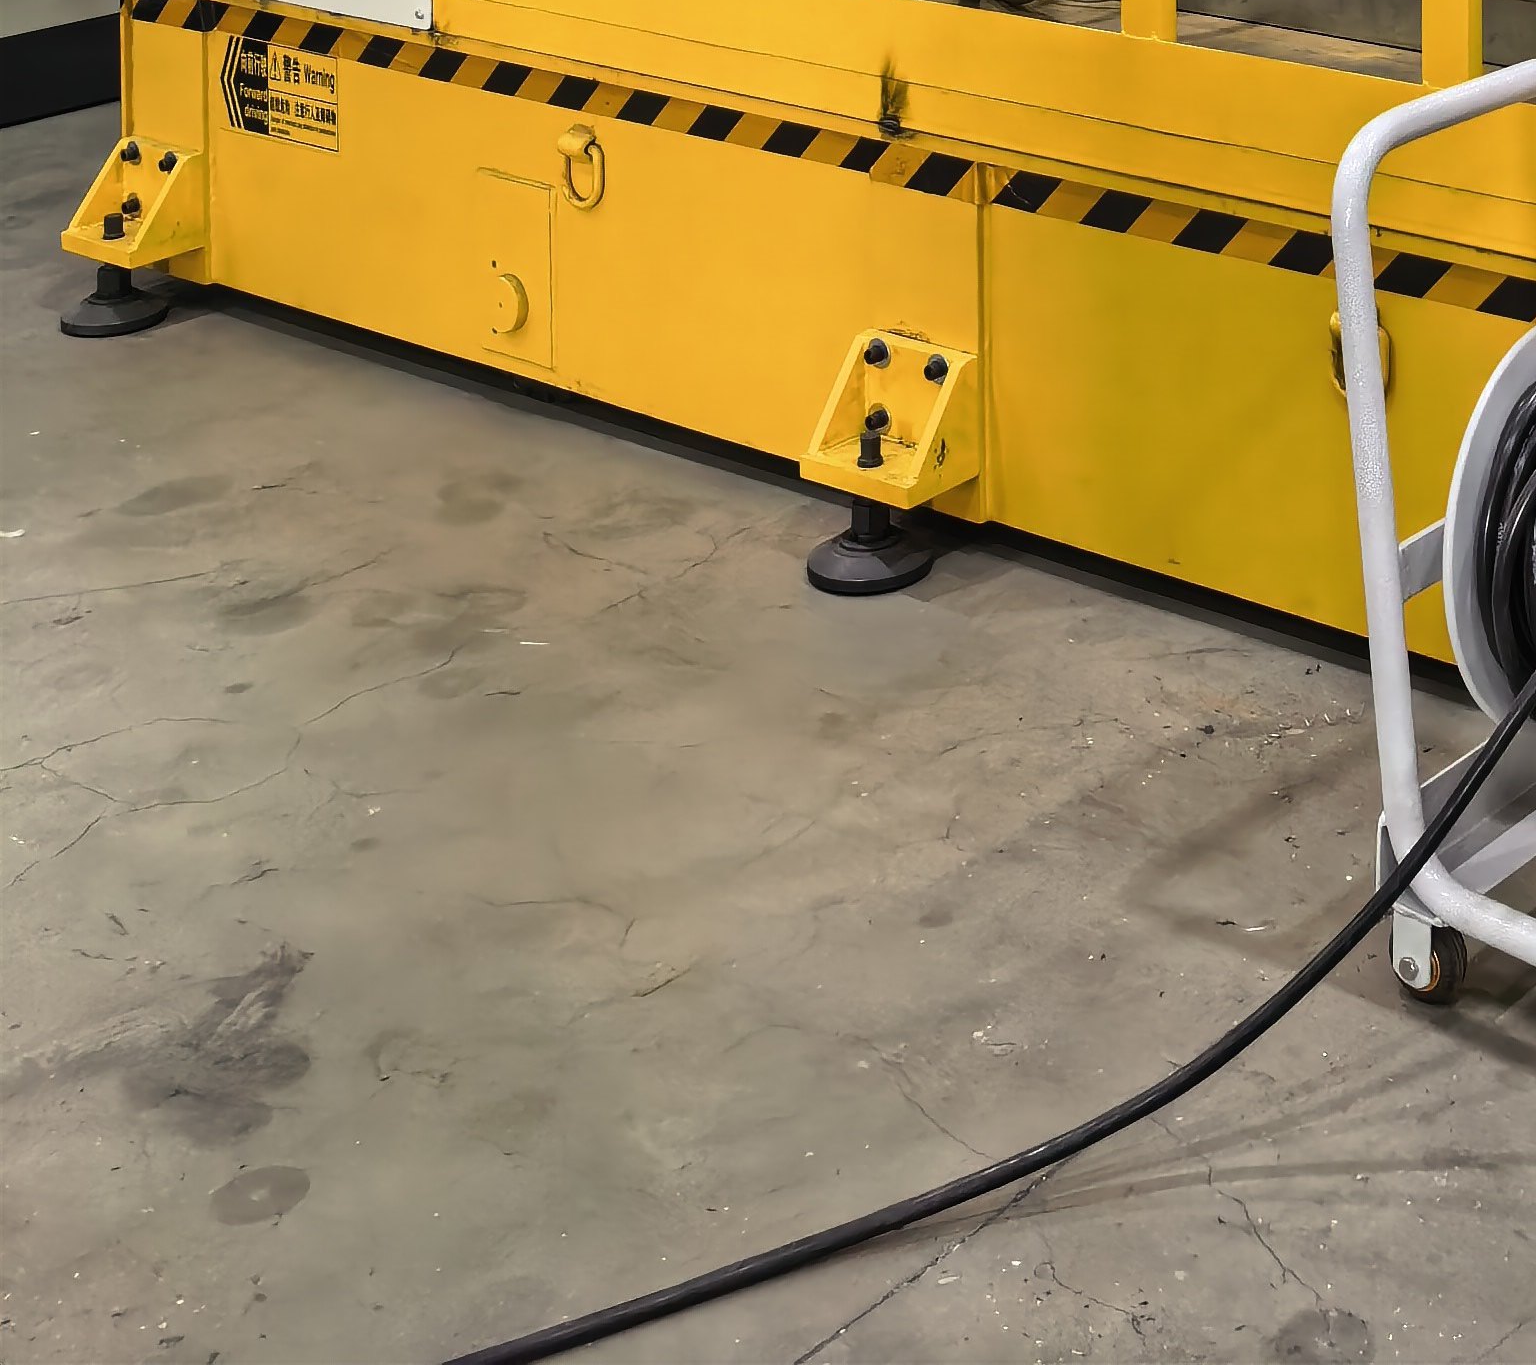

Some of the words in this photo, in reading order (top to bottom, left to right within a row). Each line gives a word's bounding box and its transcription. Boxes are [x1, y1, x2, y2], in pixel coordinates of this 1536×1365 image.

[282, 53, 301, 85] 警告
[303, 62, 336, 95] Warning
[239, 82, 268, 103] Forward
[244, 102, 268, 126] driving
